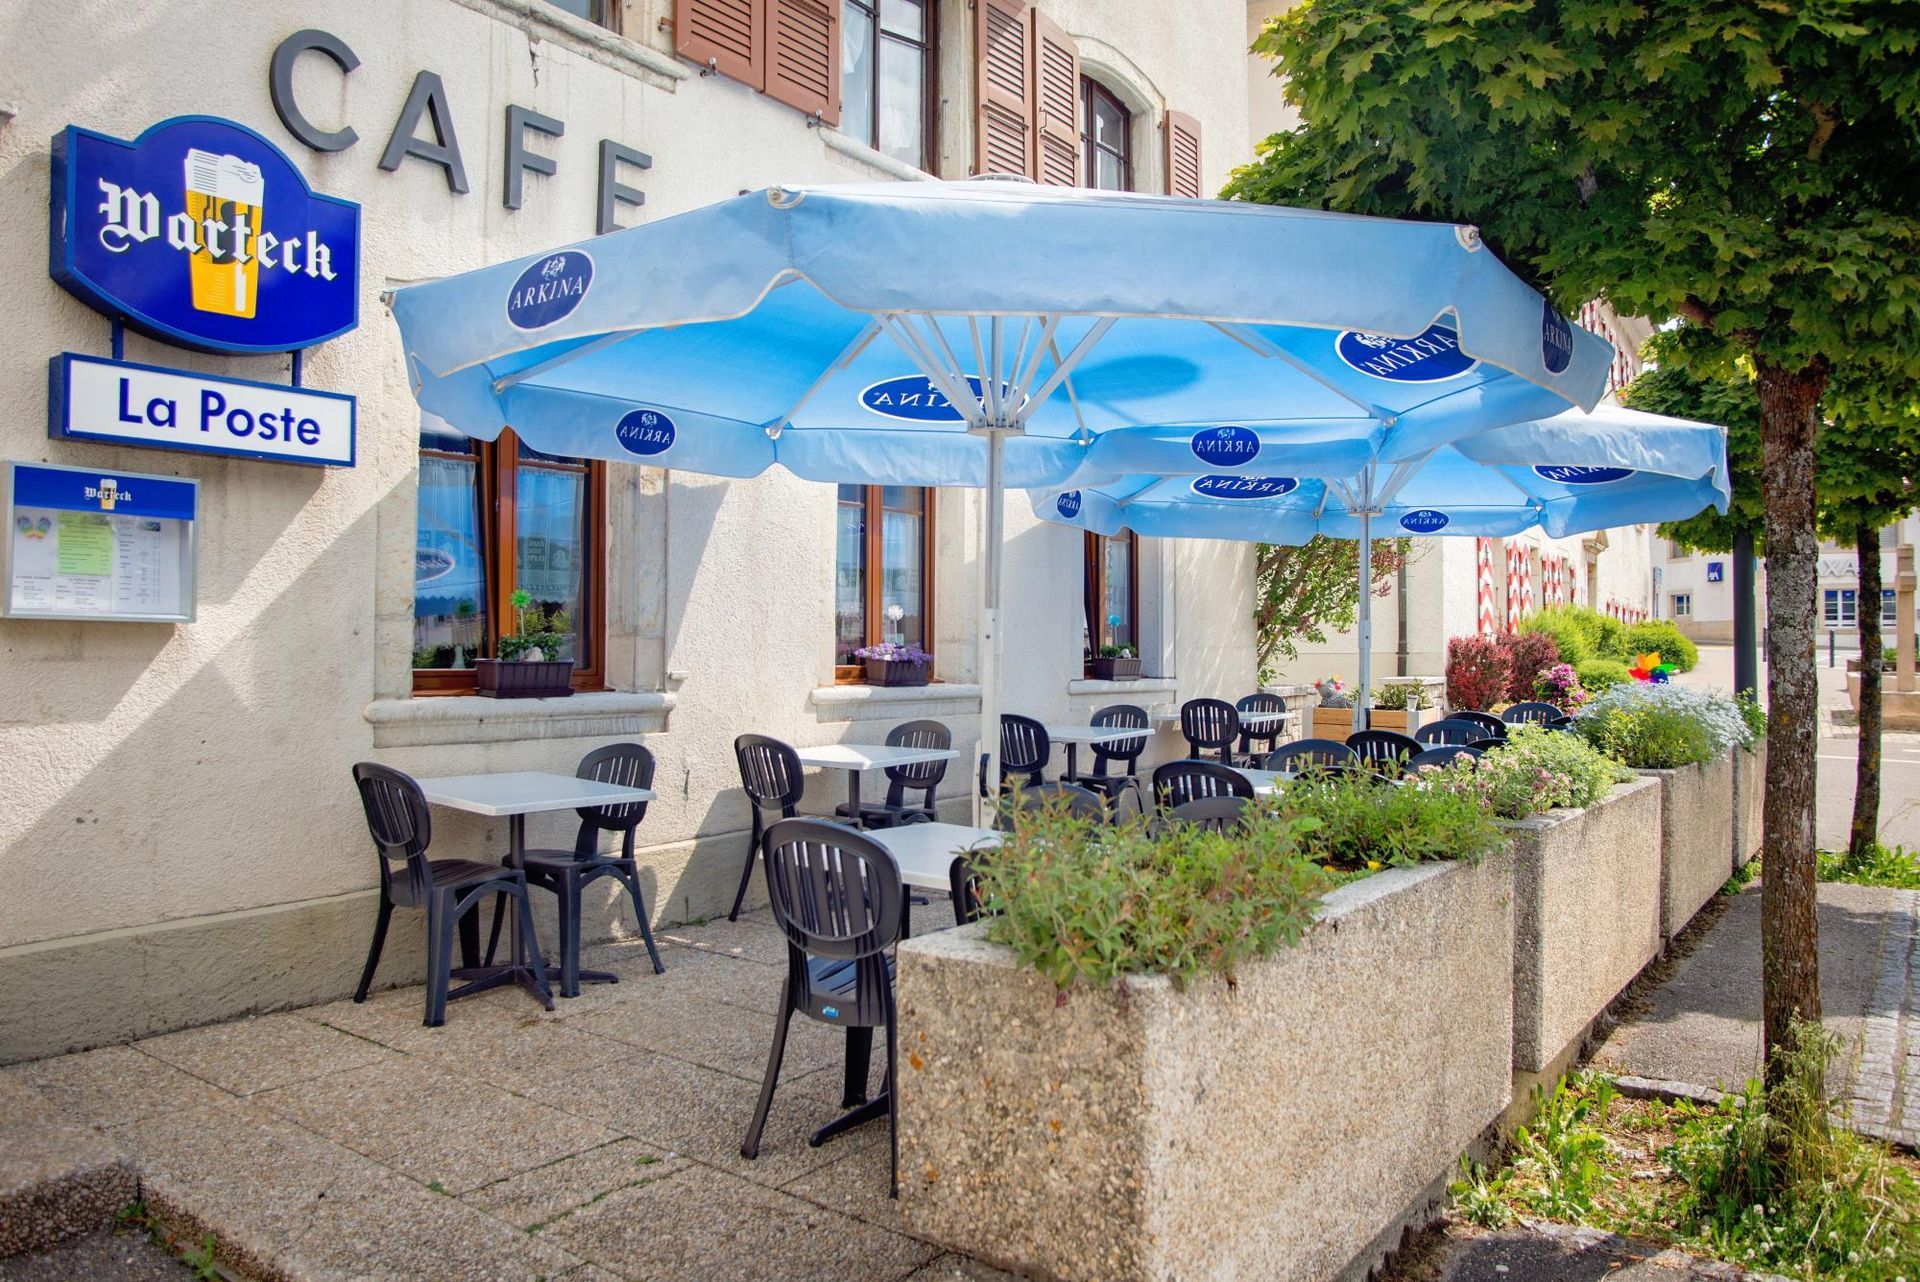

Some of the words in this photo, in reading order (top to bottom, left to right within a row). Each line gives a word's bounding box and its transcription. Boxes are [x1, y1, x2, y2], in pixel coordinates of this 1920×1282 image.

[270, 29, 652, 236] CAFE
[98, 177, 338, 282] Warteck
[511, 275, 584, 310] ARKINA
[1544, 321, 1571, 356] ARKINA
[118, 377, 178, 428] La
[200, 389, 322, 446] Poste
[84, 486, 132, 502] Warteck
[1818, 559, 1858, 578] XA
